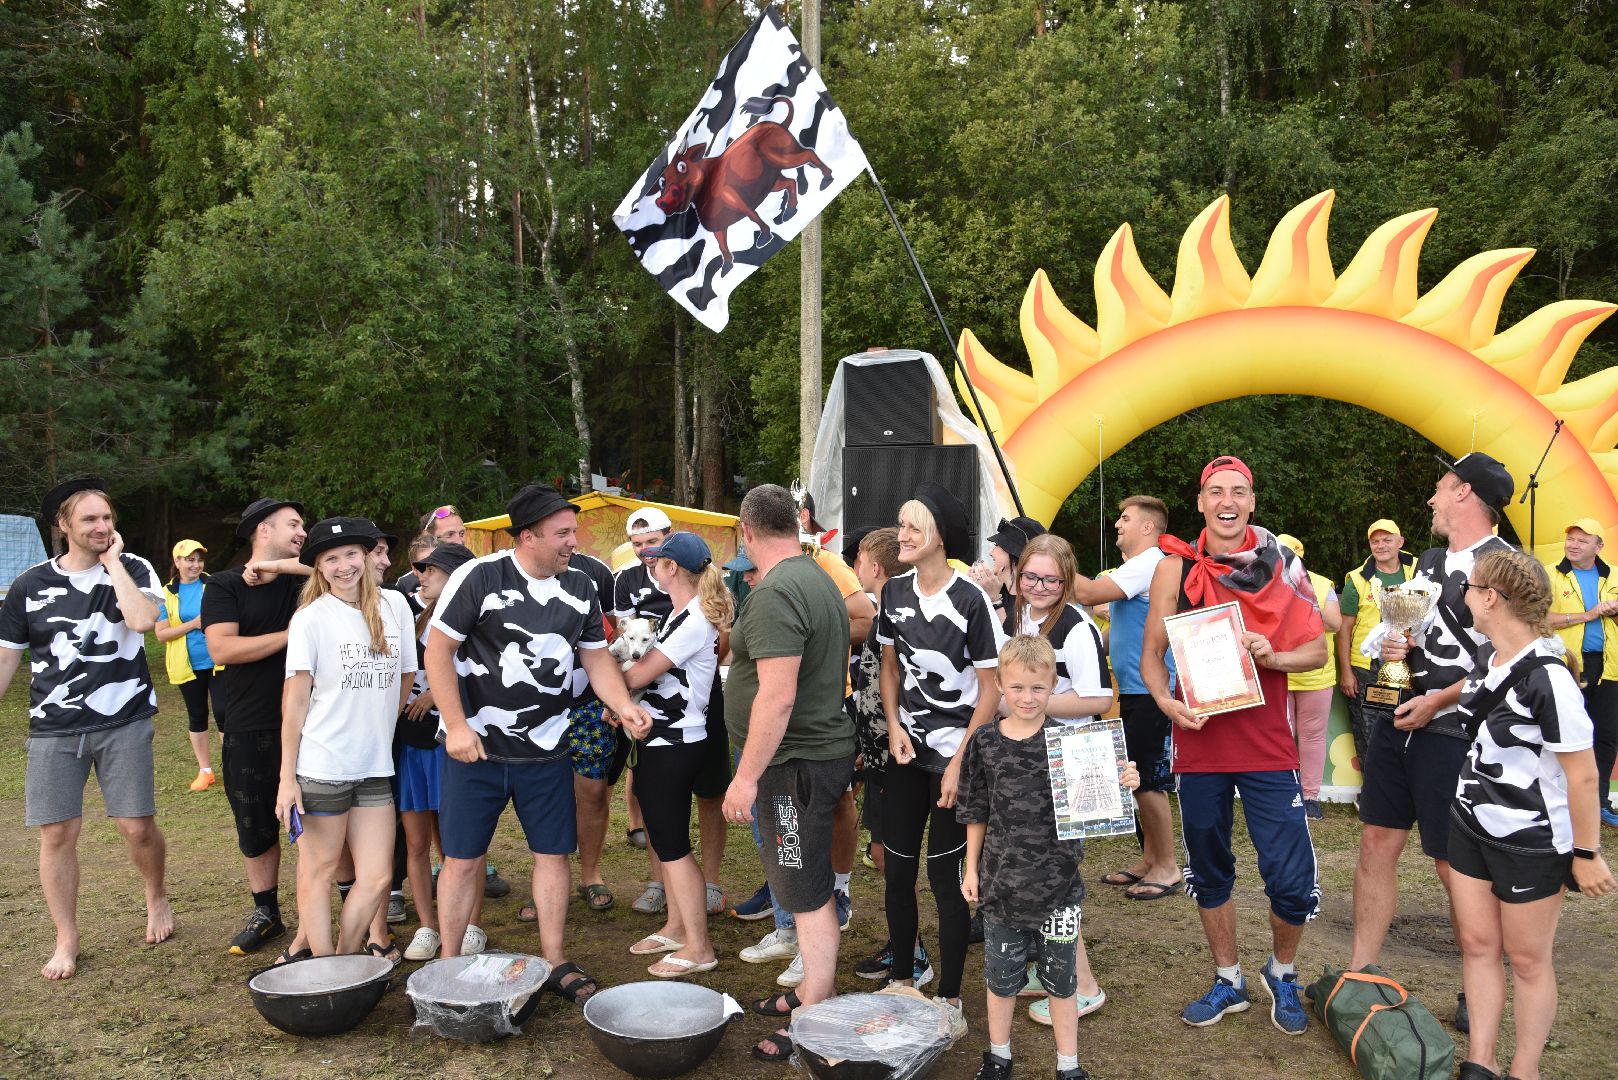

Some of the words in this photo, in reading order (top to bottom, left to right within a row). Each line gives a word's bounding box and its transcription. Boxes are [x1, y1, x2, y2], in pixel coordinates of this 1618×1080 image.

[339, 643, 354, 661] НЕ
[343, 661, 398, 671] МАТОМ
[341, 671, 373, 690] РЯДОМ
[778, 804, 803, 869] SPORT
[777, 845, 785, 866] ACTIVE
